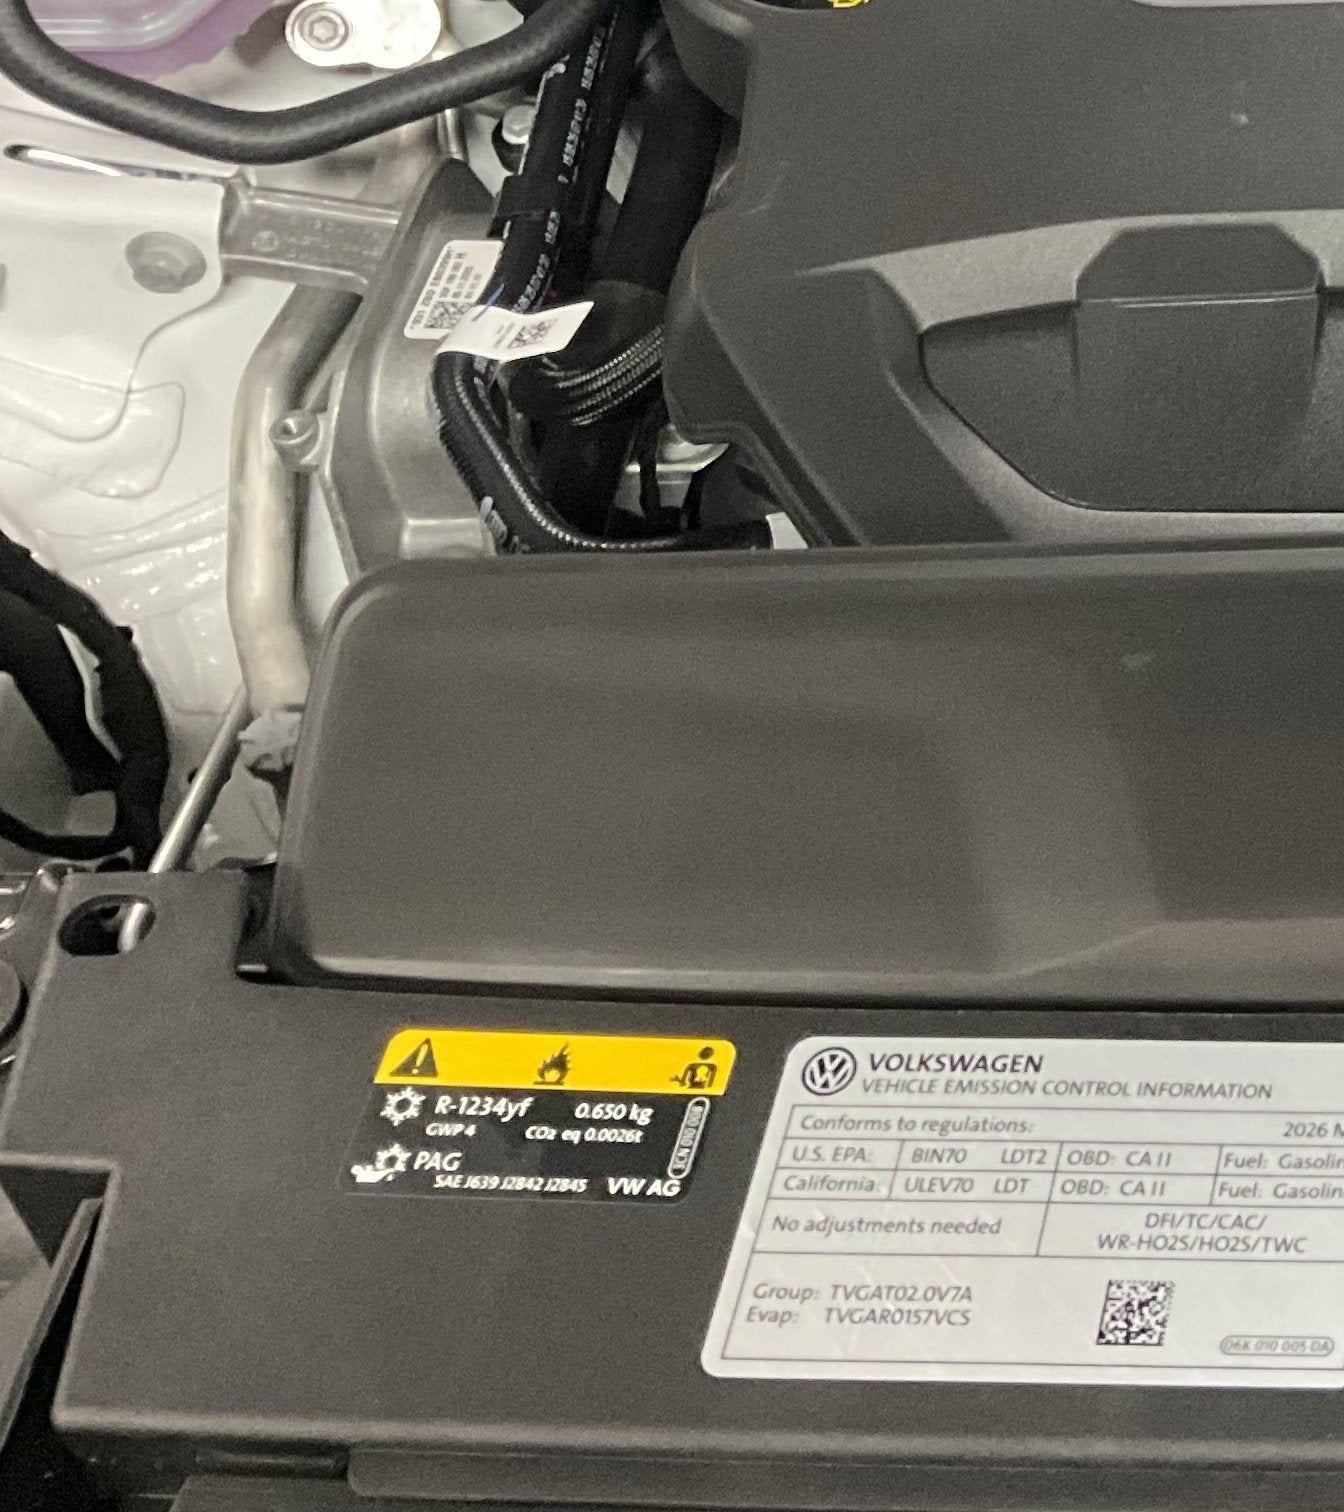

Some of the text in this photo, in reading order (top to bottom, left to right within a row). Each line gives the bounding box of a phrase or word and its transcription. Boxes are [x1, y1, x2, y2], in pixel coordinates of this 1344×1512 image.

[869, 1053, 1044, 1073] VOLKSWAGEN
[863, 1078, 1273, 1099] VEHICLE EMISSION CONTROL INFORMATION
[434, 1096, 654, 1125] R-1234yf 0.650 kg
[800, 1115, 1034, 1135] Conforms to regulations:
[1283, 1123, 1329, 1138] 2026
[414, 1151, 462, 1172] PAG
[792, 1147, 827, 1162] U.S.
[912, 1149, 1047, 1165] BIN70 LDT2
[1125, 1152, 1154, 1167] CA
[1224, 1152, 1267, 1169] Fuel:
[606, 1177, 646, 1195] VW
[649, 1179, 681, 1196] AG
[784, 1175, 880, 1192] California:
[905, 1177, 1030, 1194] ULEV70 LDT
[1119, 1180, 1148, 1196] CA
[1218, 1183, 1262, 1198] Fuel:
[772, 1215, 1002, 1237] No adjustments needed
[1144, 1212, 1269, 1230] DFI/TC/CAC/
[753, 1282, 820, 1304] Group:
[746, 1306, 800, 1327] Evap:
